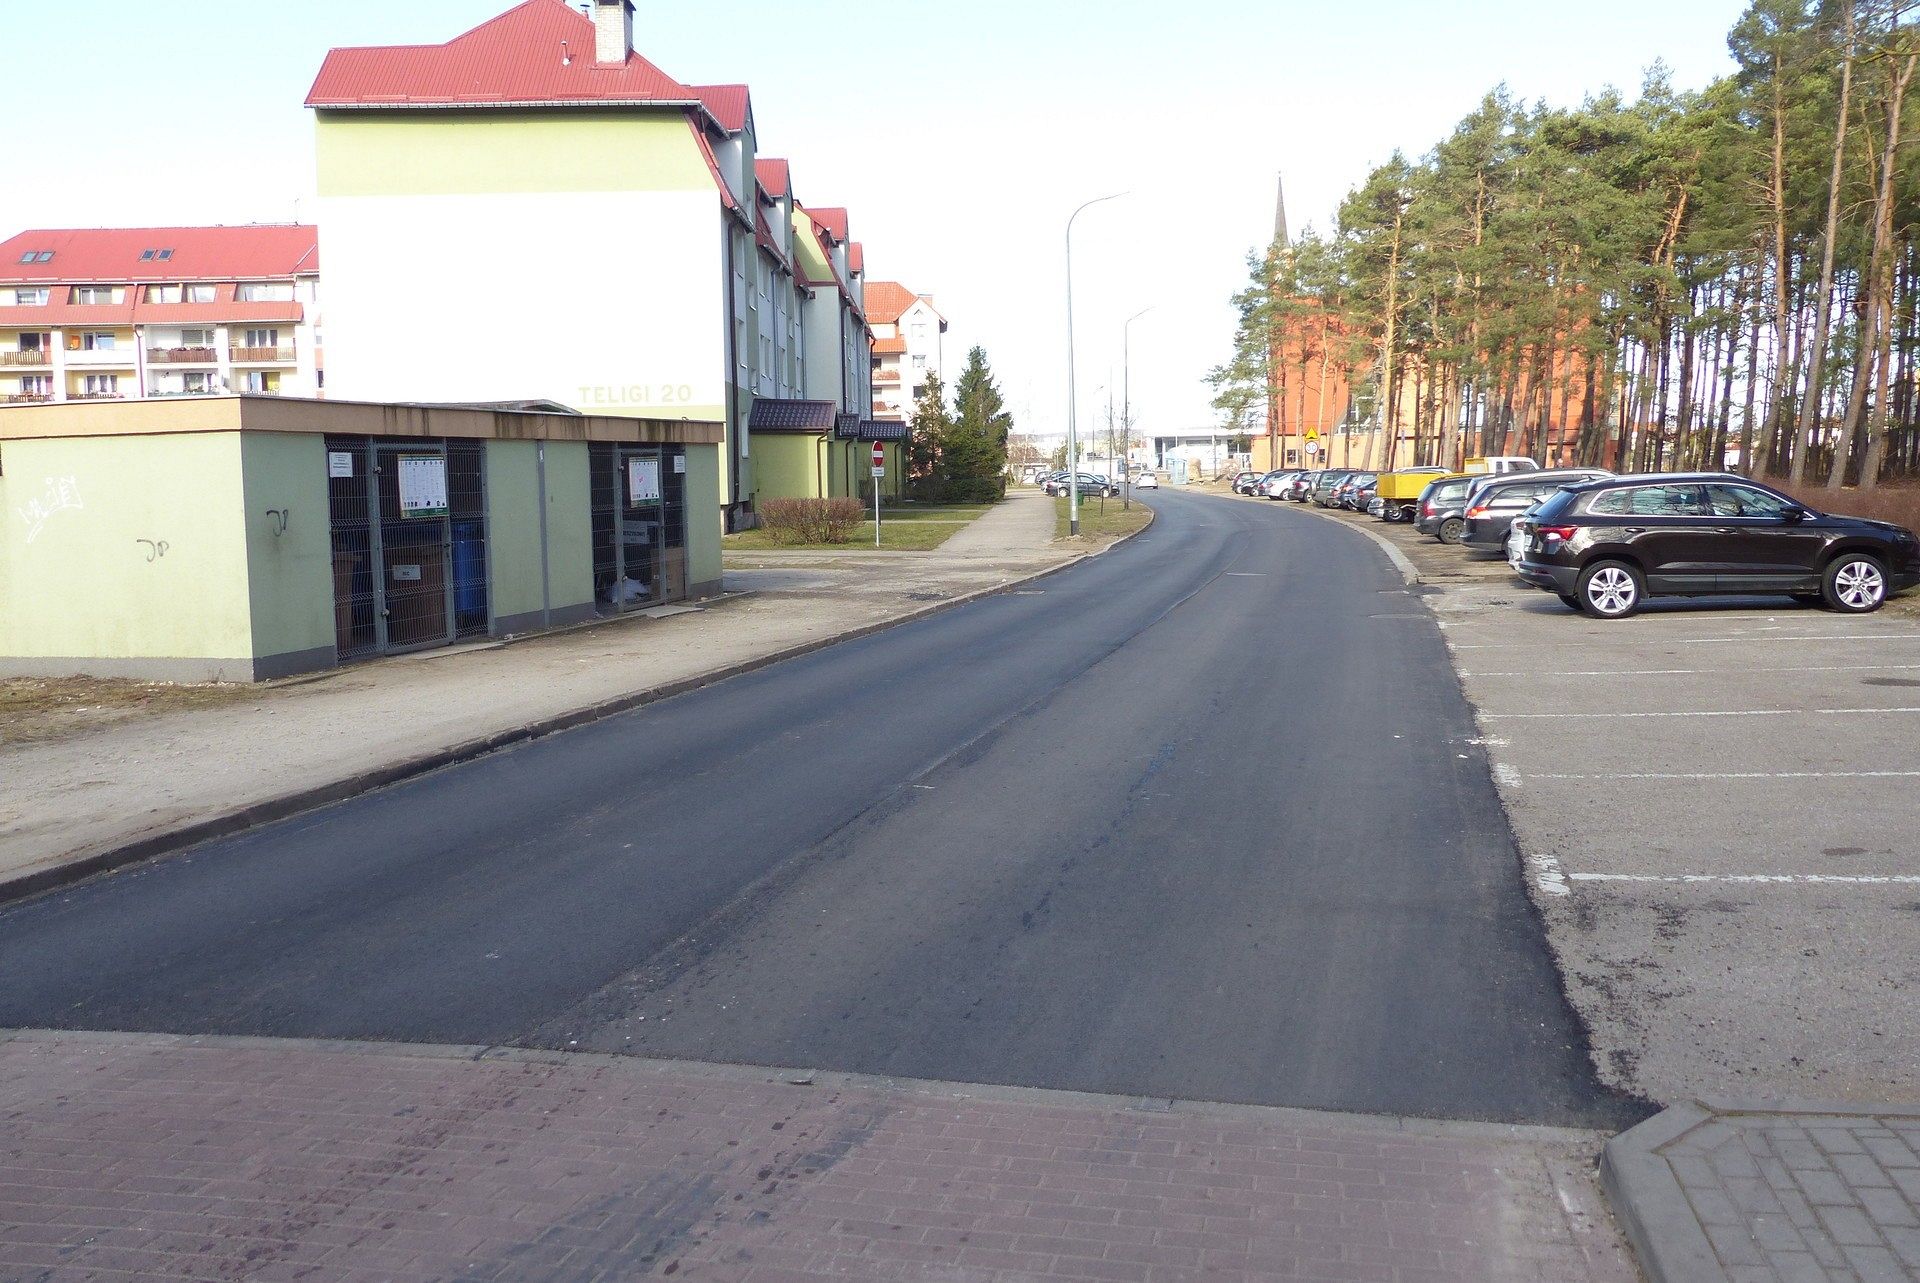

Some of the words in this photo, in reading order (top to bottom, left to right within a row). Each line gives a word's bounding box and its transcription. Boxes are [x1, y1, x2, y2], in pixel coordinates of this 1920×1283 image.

[578, 385, 649, 404] TELIGI
[661, 384, 692, 402] 20
[1307, 444, 1317, 452] 30
